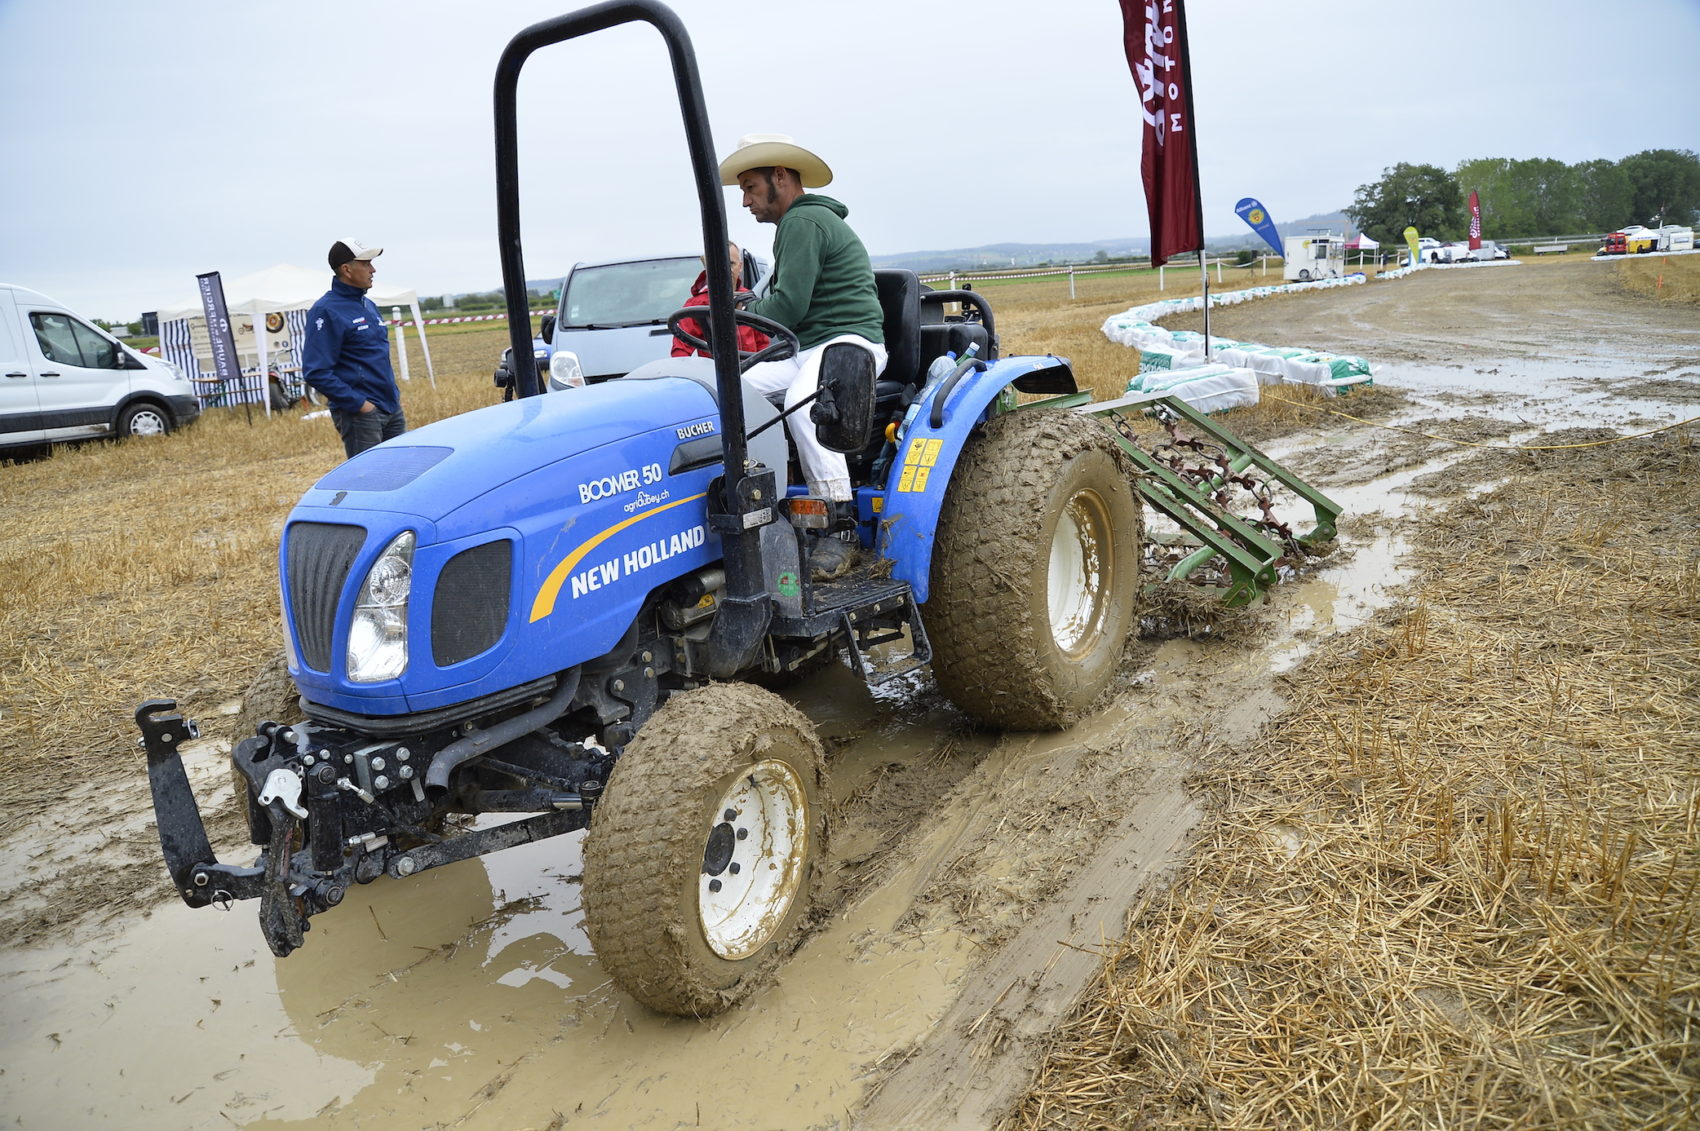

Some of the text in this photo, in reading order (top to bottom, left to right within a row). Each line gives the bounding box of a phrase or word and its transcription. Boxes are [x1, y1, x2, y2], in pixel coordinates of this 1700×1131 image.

[677, 421, 715, 440] BUCHER
[578, 463, 662, 504] BOOMER 50
[571, 525, 705, 599] NEW HOLLAND
